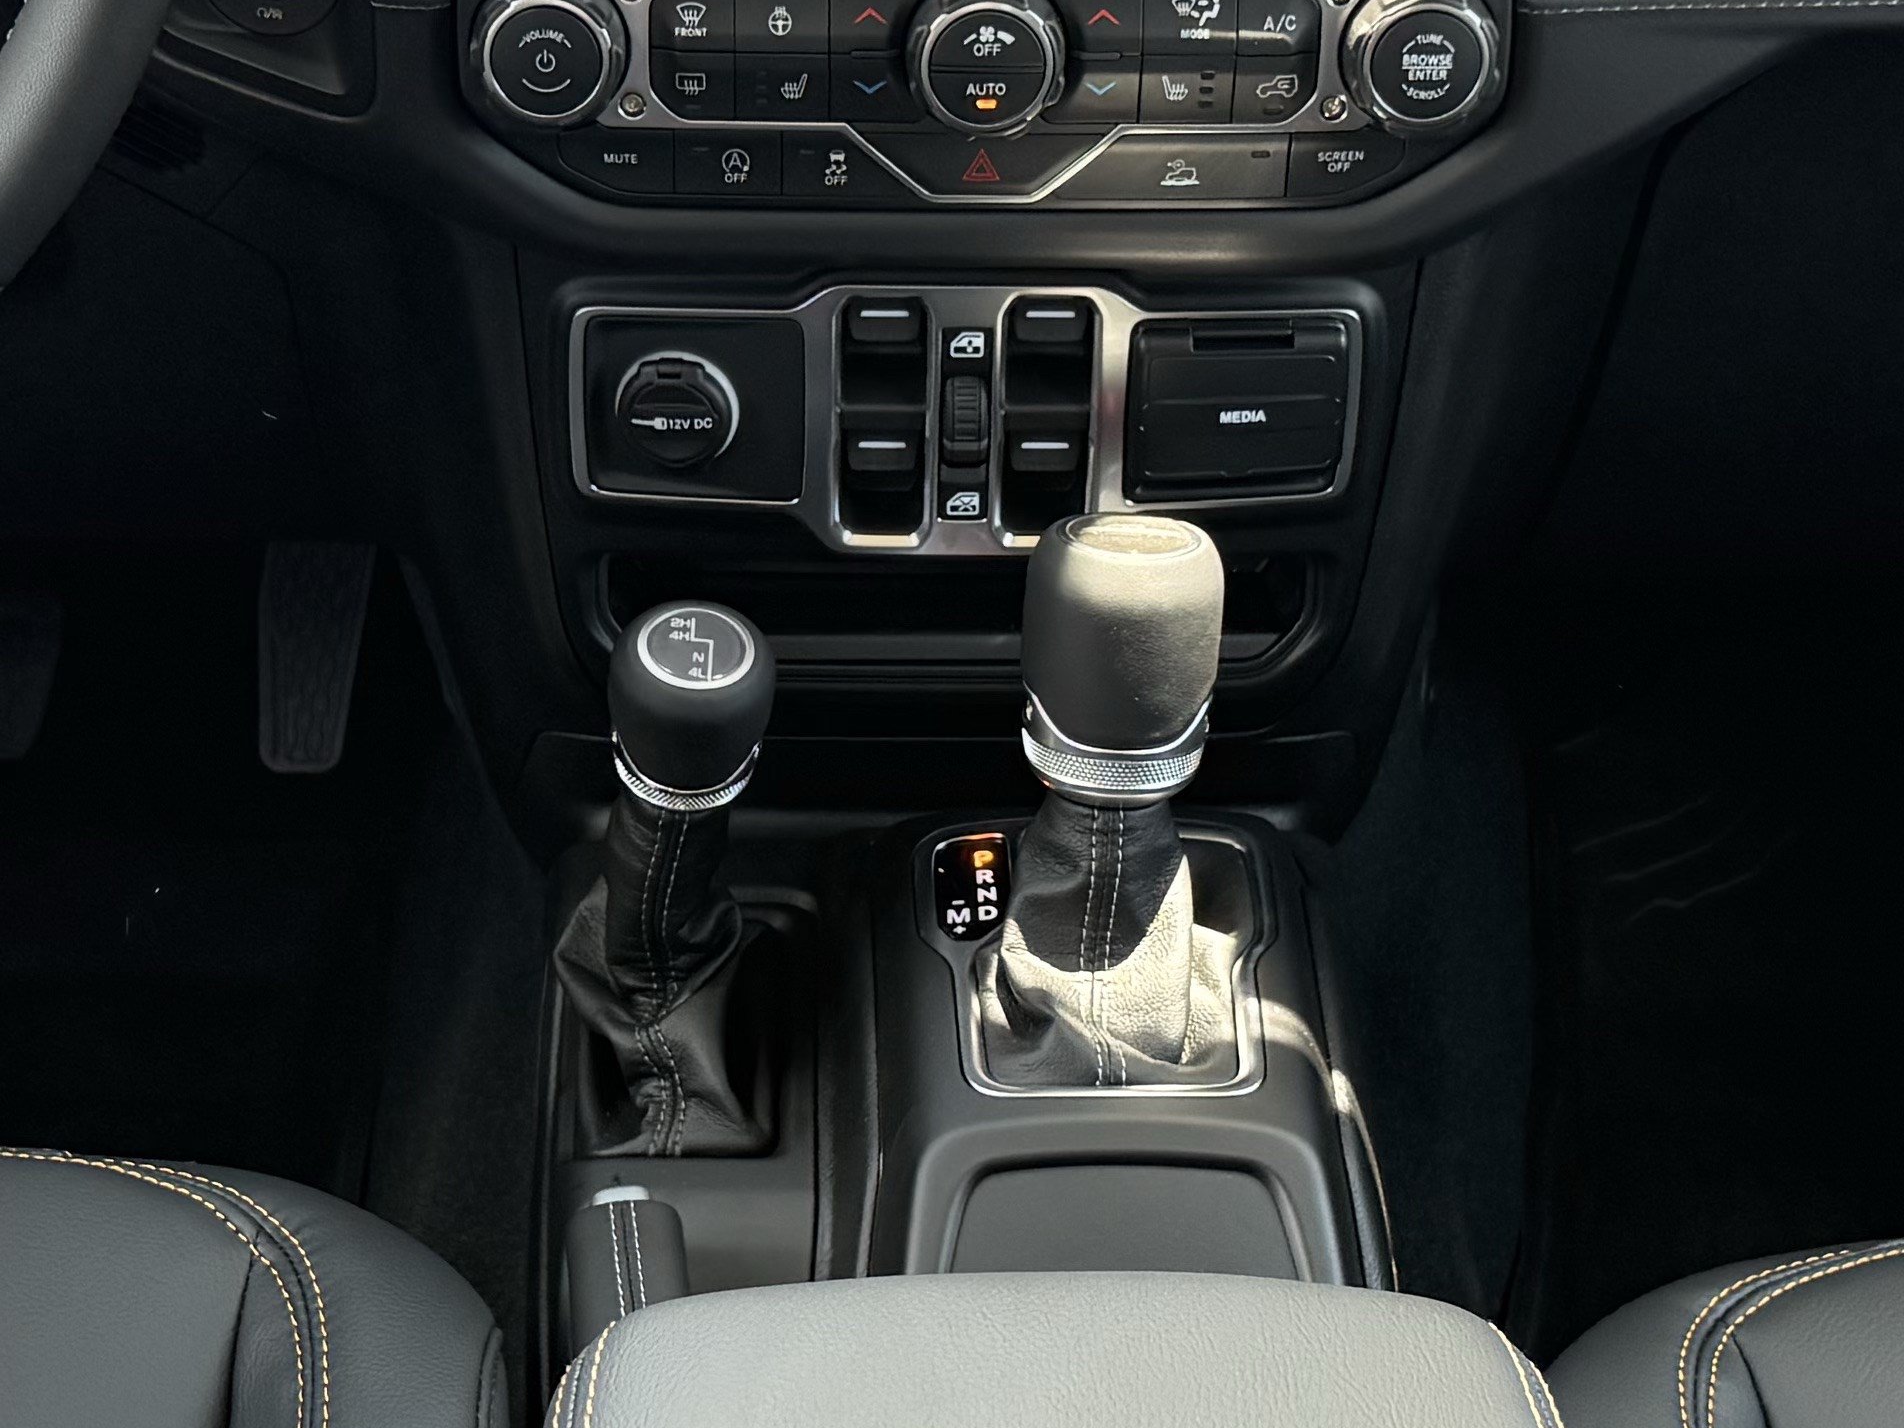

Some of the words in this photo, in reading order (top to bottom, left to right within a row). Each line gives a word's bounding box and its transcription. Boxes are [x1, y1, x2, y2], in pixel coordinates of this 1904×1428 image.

[1264, 14, 1297, 32] A/C
[523, 29, 564, 43] VOLUME
[674, 26, 707, 38] FRONT
[1181, 29, 1210, 40] MODE
[1416, 34, 1444, 45] TUNE
[973, 44, 1002, 58] OFF
[1402, 54, 1453, 66] BROWSE
[1408, 69, 1448, 81] ENTER
[966, 83, 1007, 97] AUTO
[1407, 87, 1446, 100] SCROLL
[604, 153, 638, 165] MUTE
[1318, 150, 1364, 163] SCREEN
[1327, 161, 1350, 173] OFF
[724, 172, 748, 184] OFF
[824, 174, 848, 186] OFF
[1219, 409, 1266, 424] MEDIA
[669, 419, 690, 430] 12V
[694, 418, 713, 429] DC
[670, 618, 690, 628] 2H
[669, 631, 689, 641] 4H
[692, 652, 704, 663] N
[688, 669, 706, 678] 4L
[973, 850, 994, 868] P
[975, 870, 994, 885] R
[977, 887, 997, 903] N
[947, 909, 971, 924] M
[978, 906, 998, 921] D
